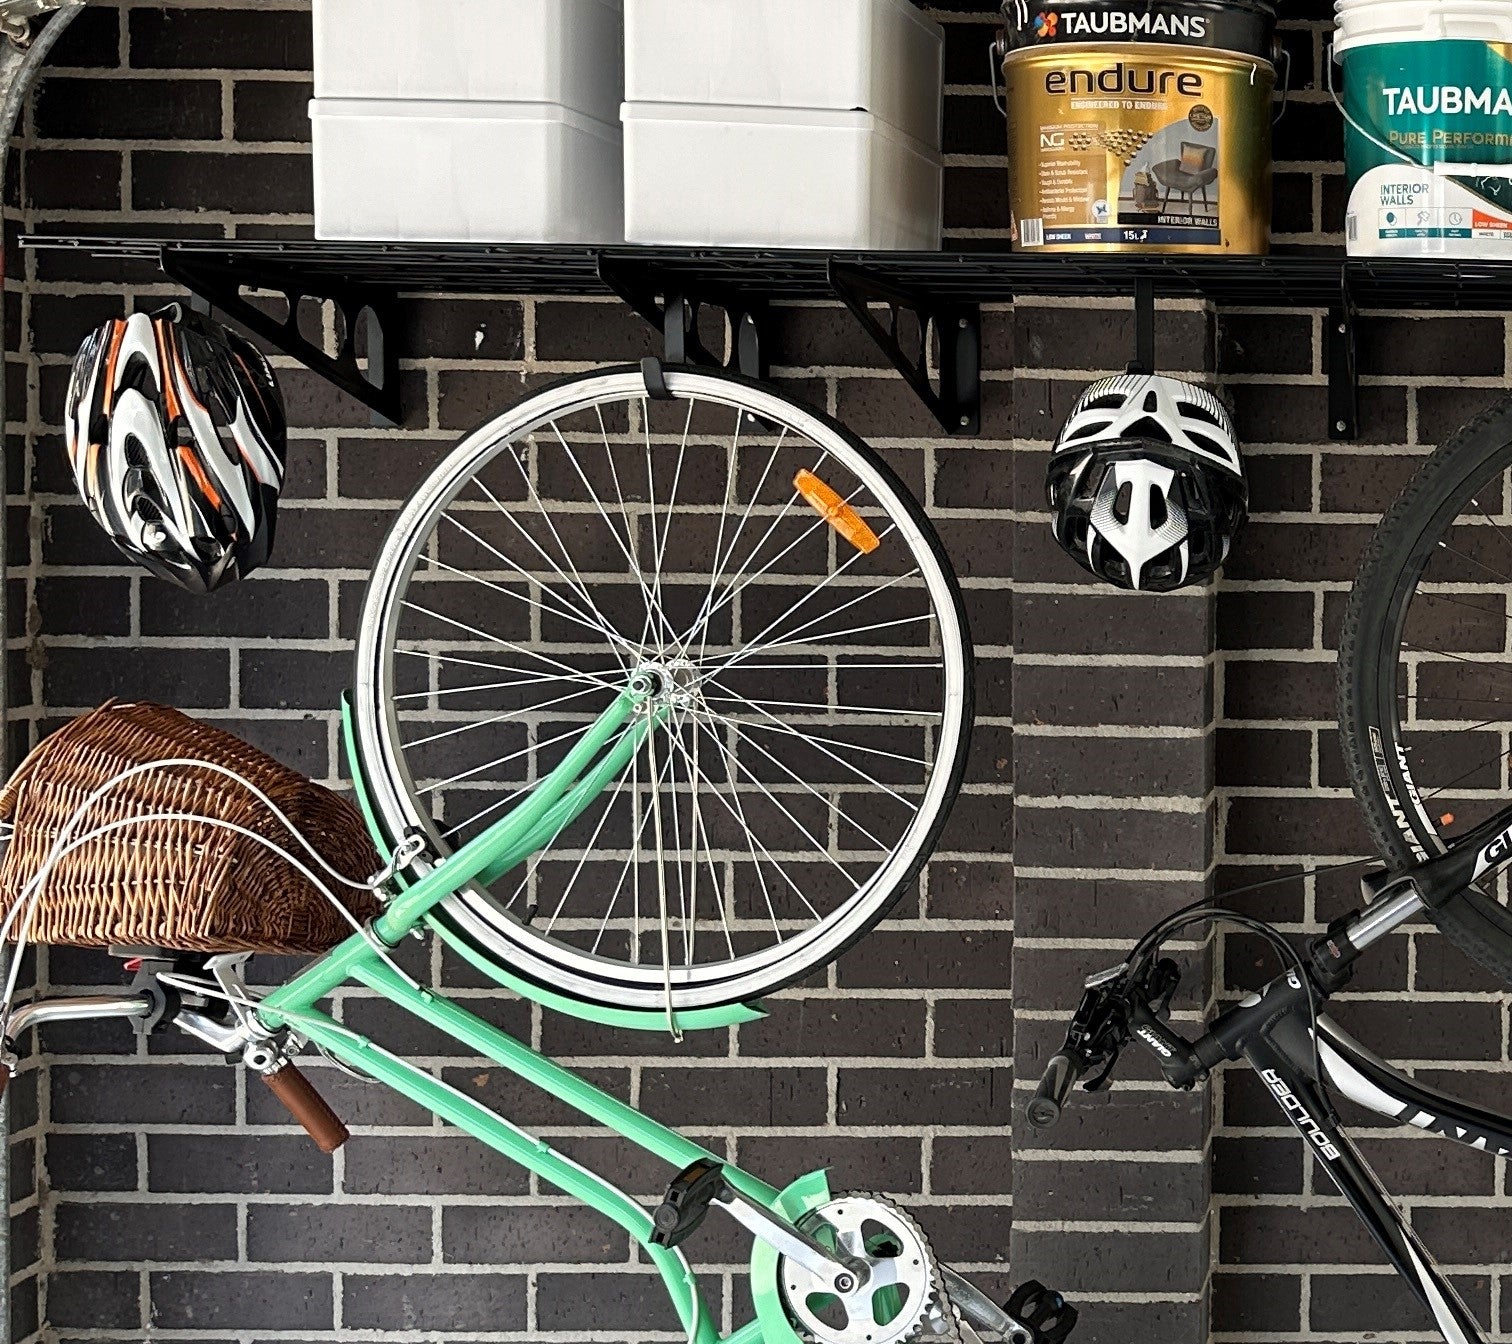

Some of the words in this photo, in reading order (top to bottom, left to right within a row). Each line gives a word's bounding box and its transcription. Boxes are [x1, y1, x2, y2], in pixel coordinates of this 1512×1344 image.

[1061, 11, 1206, 38] TAUBMANS
[1045, 62, 1203, 98] endure
[1389, 130, 1426, 145] PURE
[1380, 183, 1430, 194] INTERIOR
[1380, 195, 1414, 206] WALLS
[1194, 216, 1218, 227] WALLS
[1394, 741, 1423, 807] GIANT
[1136, 1029, 1172, 1058] GIANT
[1261, 1068, 1341, 1162] BOULDER
